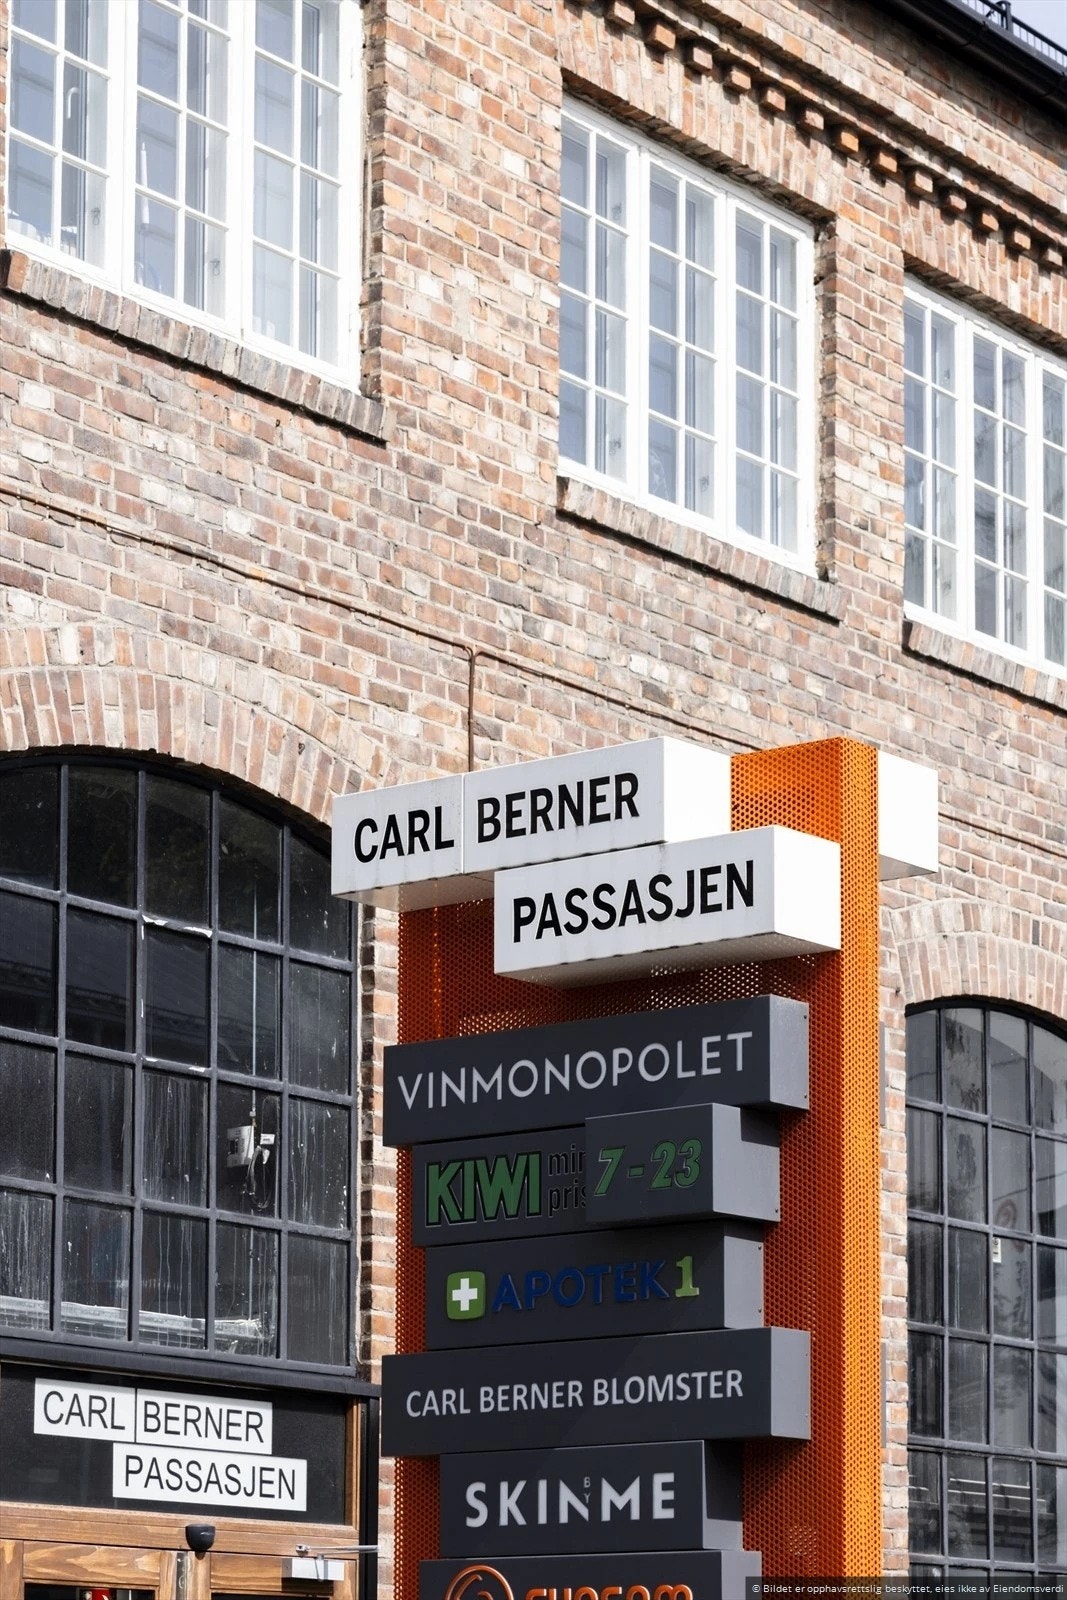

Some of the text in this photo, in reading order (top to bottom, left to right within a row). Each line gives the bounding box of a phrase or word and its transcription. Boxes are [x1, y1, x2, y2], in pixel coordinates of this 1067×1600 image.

[354, 772, 640, 863] CARL BERNER
[512, 860, 755, 943] PASSASJEN
[397, 1031, 753, 1110] VINMONOPOLET
[425, 1151, 543, 1228] KIWI
[493, 1255, 701, 1313] APOTEK 1
[43, 1391, 264, 1443] CARL BERNER
[405, 1369, 744, 1417] CARL BERNER BLOMSTER
[125, 1455, 296, 1500] PASSASJEN
